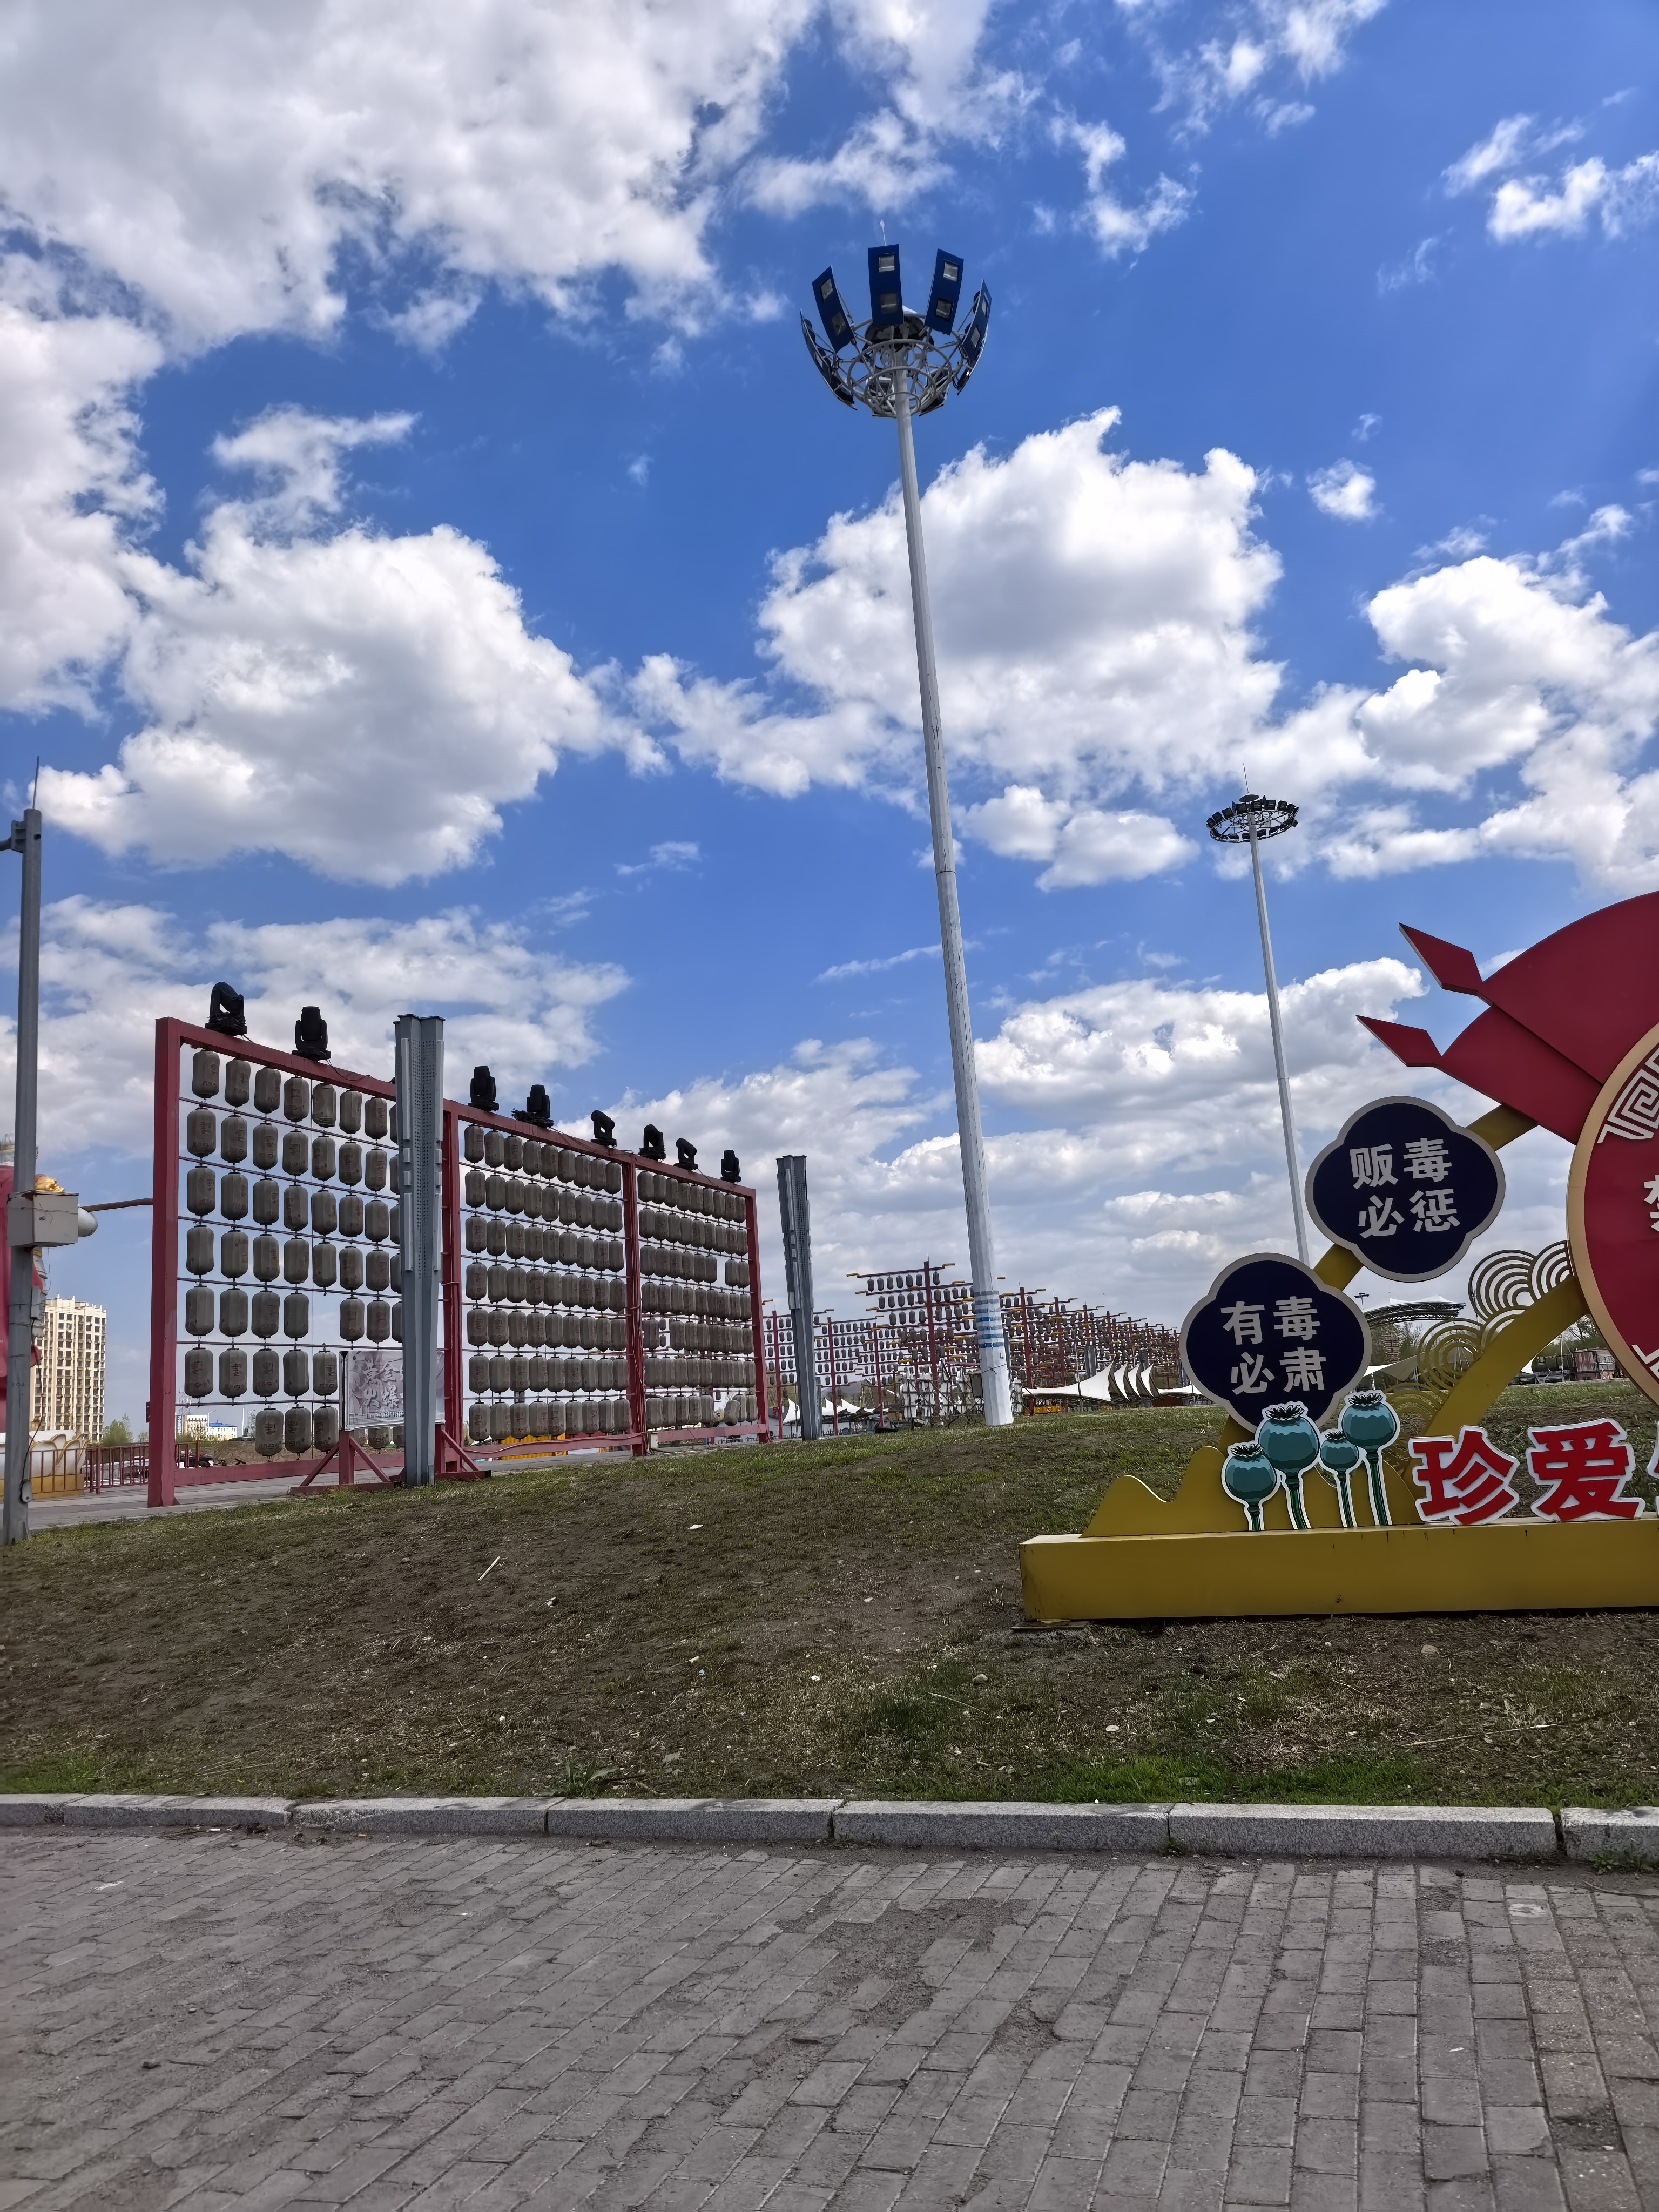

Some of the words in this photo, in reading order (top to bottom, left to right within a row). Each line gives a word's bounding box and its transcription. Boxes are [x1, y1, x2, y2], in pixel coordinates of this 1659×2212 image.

[1350, 1138, 1452, 1189] 贩毒
[1358, 1189, 1460, 1238] 必惩
[1220, 1296, 1320, 1345] 有毒
[362, 1358, 403, 1385] 黄金
[1230, 1346, 1326, 1395] 必肃
[362, 1386, 403, 1410] 火爆
[1408, 1418, 1659, 1525] 珍爱
